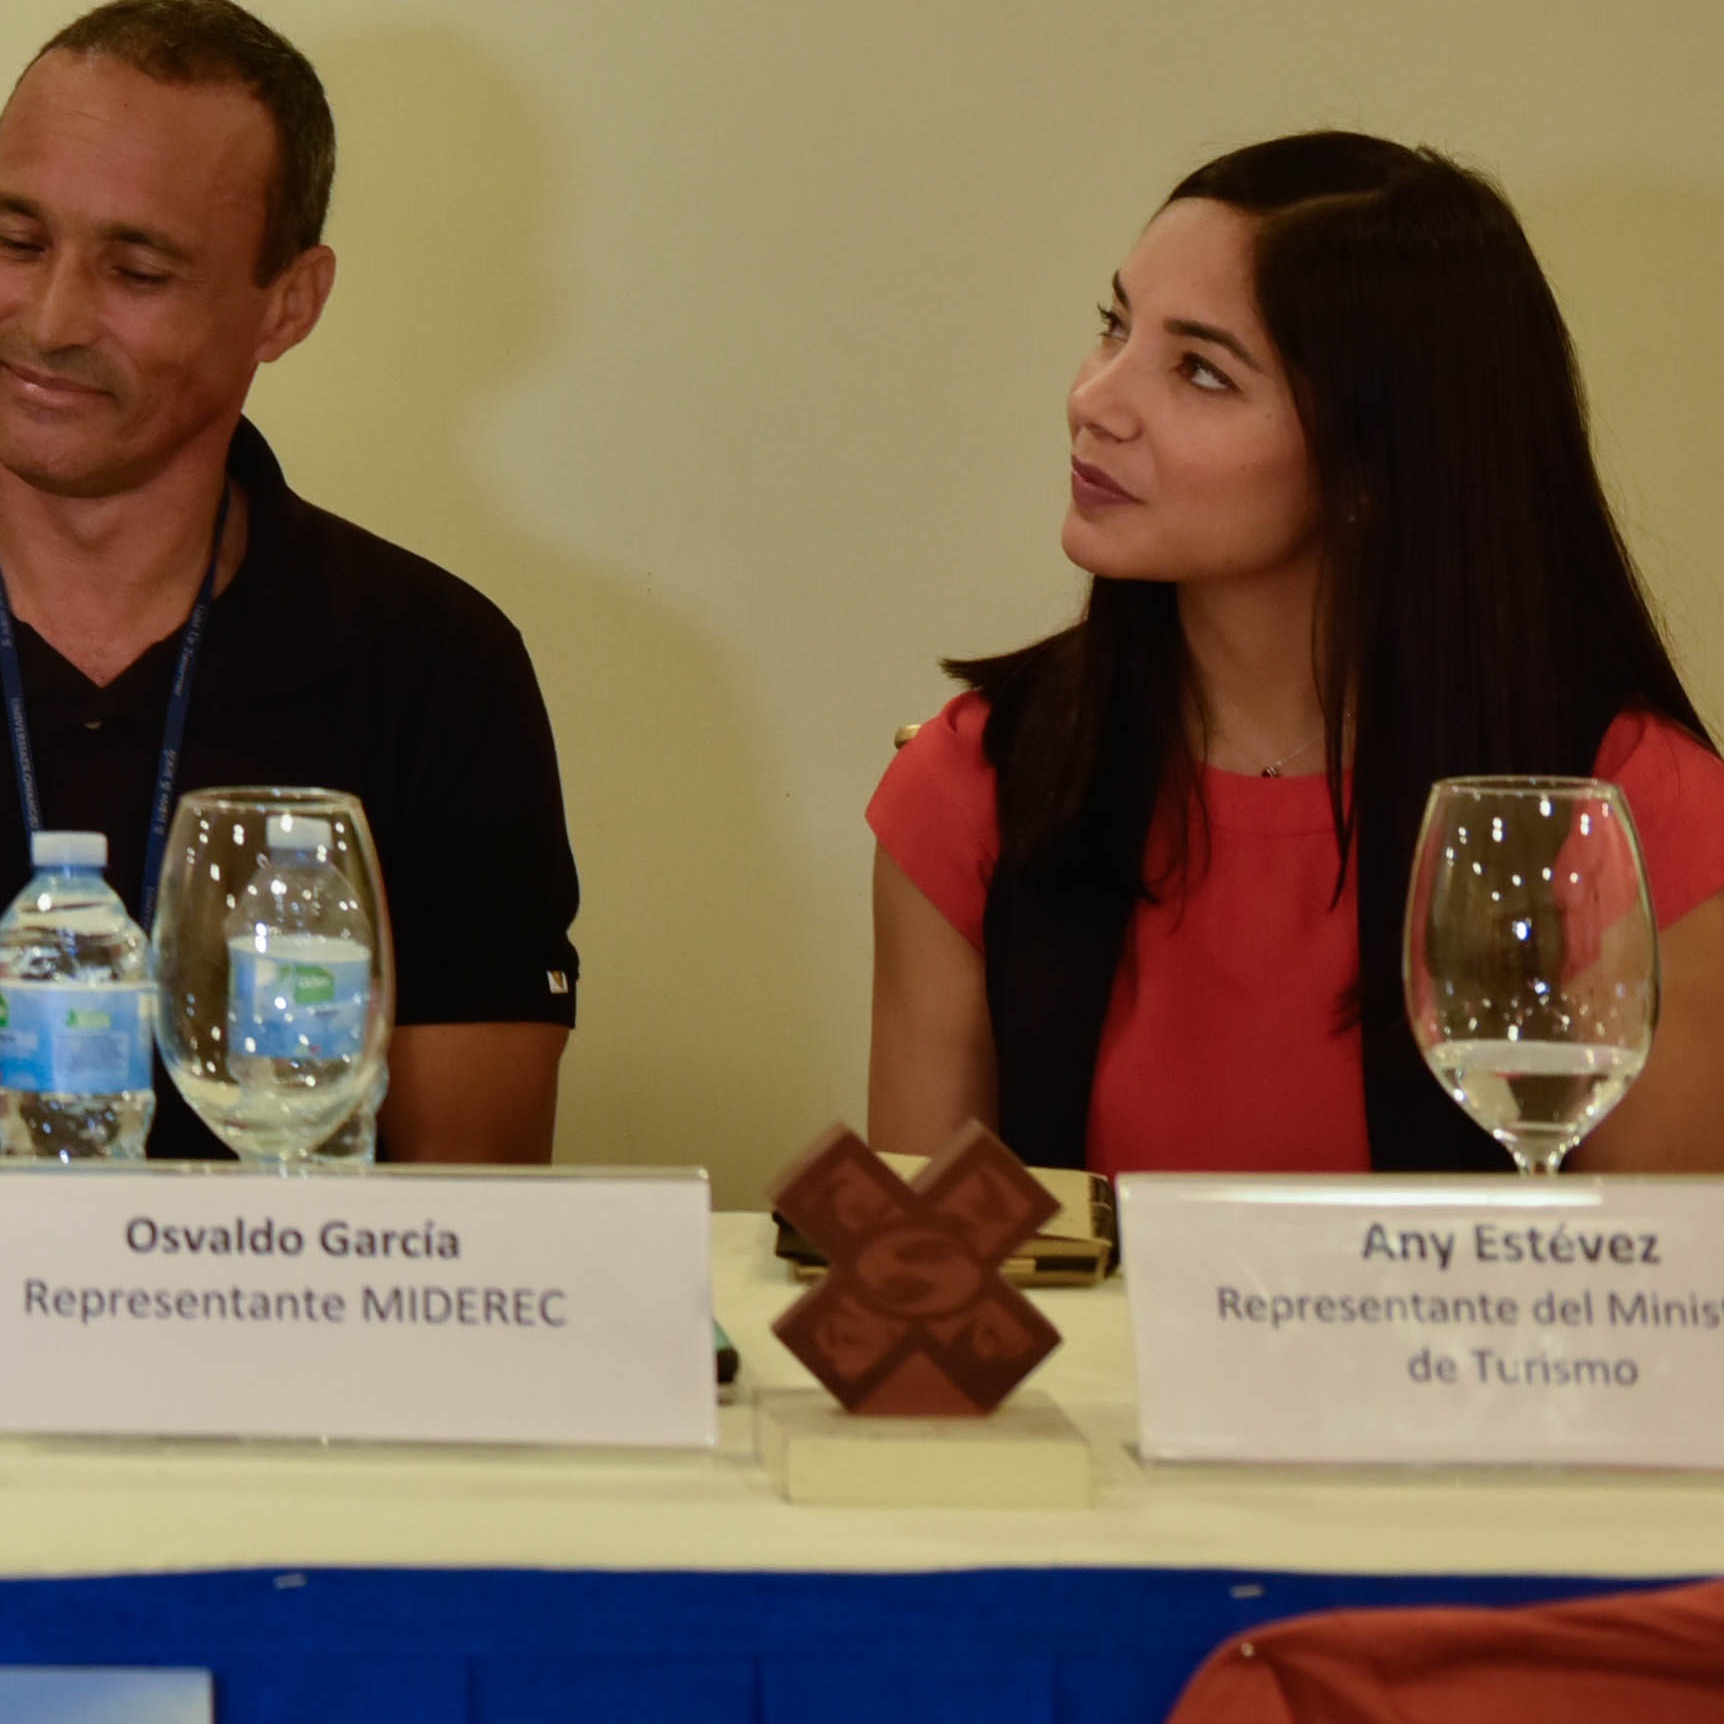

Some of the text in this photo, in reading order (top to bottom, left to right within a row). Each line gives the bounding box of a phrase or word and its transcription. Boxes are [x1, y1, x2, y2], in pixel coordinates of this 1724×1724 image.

[125, 1217, 461, 1261] Osvaldo García
[1361, 1221, 1662, 1273] Any Estévez
[24, 1279, 568, 1328] Representante MIDEREC
[1218, 1286, 1724, 1331] Representante del Minis
[1408, 1349, 1640, 1388] de Turismo
